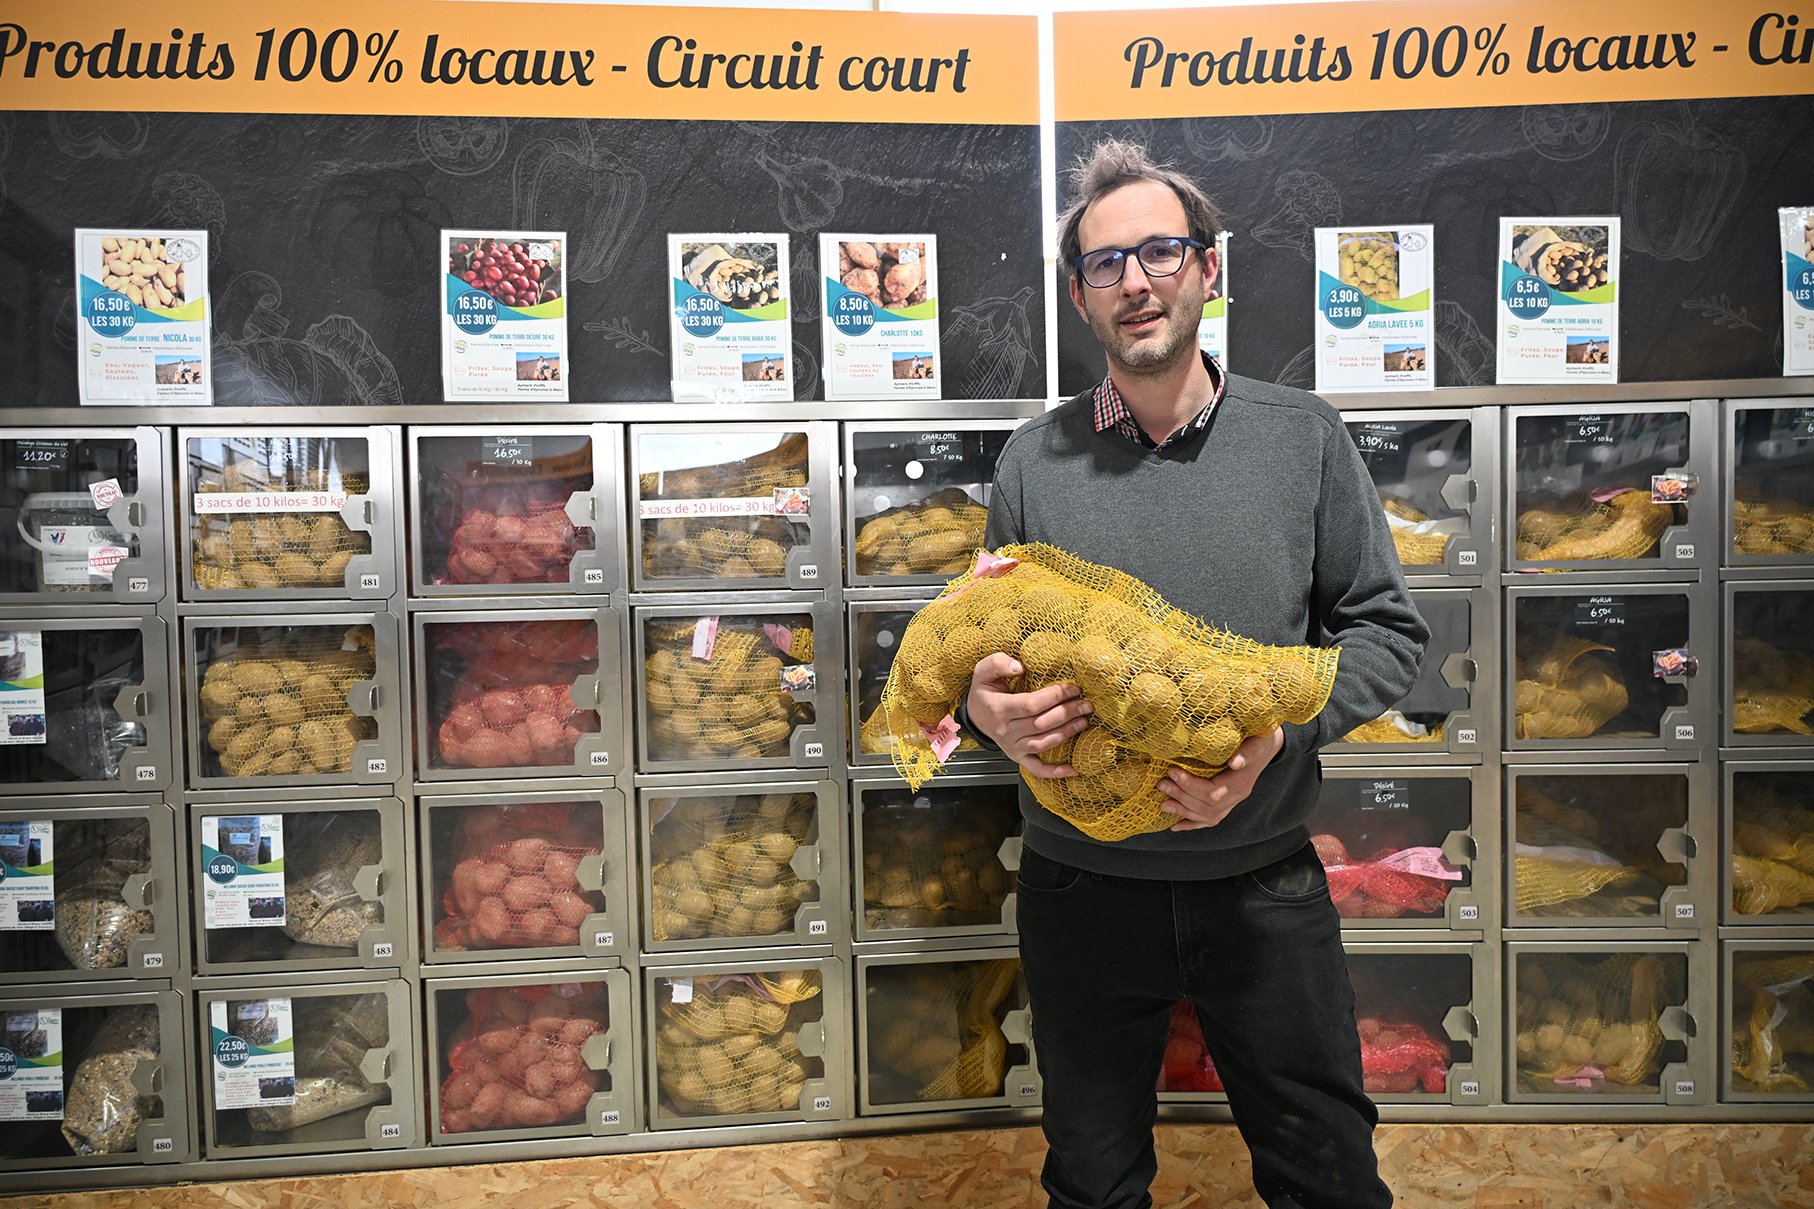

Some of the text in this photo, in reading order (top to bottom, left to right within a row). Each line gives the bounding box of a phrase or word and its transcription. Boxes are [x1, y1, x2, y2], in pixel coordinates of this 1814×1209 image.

[0, 22, 236, 81] Produits
[253, 27, 404, 84] 100%
[420, 34, 595, 87] locaux
[646, 35, 824, 90] Circuit
[838, 48, 972, 94] court
[1123, 33, 1353, 88] Produits
[1370, 24, 1511, 80] 100%
[1526, 24, 1698, 74] locaux
[1516, 280, 1540, 294] 6,5€
[1330, 290, 1358, 303] 3,90€
[1796, 290, 1810, 300] LES
[93, 298, 130, 312] 16,50€
[458, 296, 493, 310] 16,50€
[686, 298, 720, 312] 16,50€
[840, 298, 868, 311] 8,50€
[1510, 298, 1548, 308] LES 10 KG
[1329, 307, 1361, 318] LES 5 KG
[92, 316, 134, 326] LES 30 KG
[457, 314, 497, 325] LES 30 KG
[686, 316, 723, 326] LES 30 KG
[836, 315, 873, 325] LES 10 KG
[1368, 320, 1387, 328] AGRIA
[1388, 320, 1408, 328] LAVEE
[1415, 320, 1424, 328] KG
[163, 334, 187, 342] NICOLA
[196, 495, 344, 509] 3 sacs de 10 kilos= 30 kg
[648, 505, 672, 515] sacs
[675, 504, 689, 514] de
[693, 504, 706, 514] 10
[710, 502, 742, 513] kilos=
[745, 502, 759, 512] 30
[762, 501, 774, 513] kg
